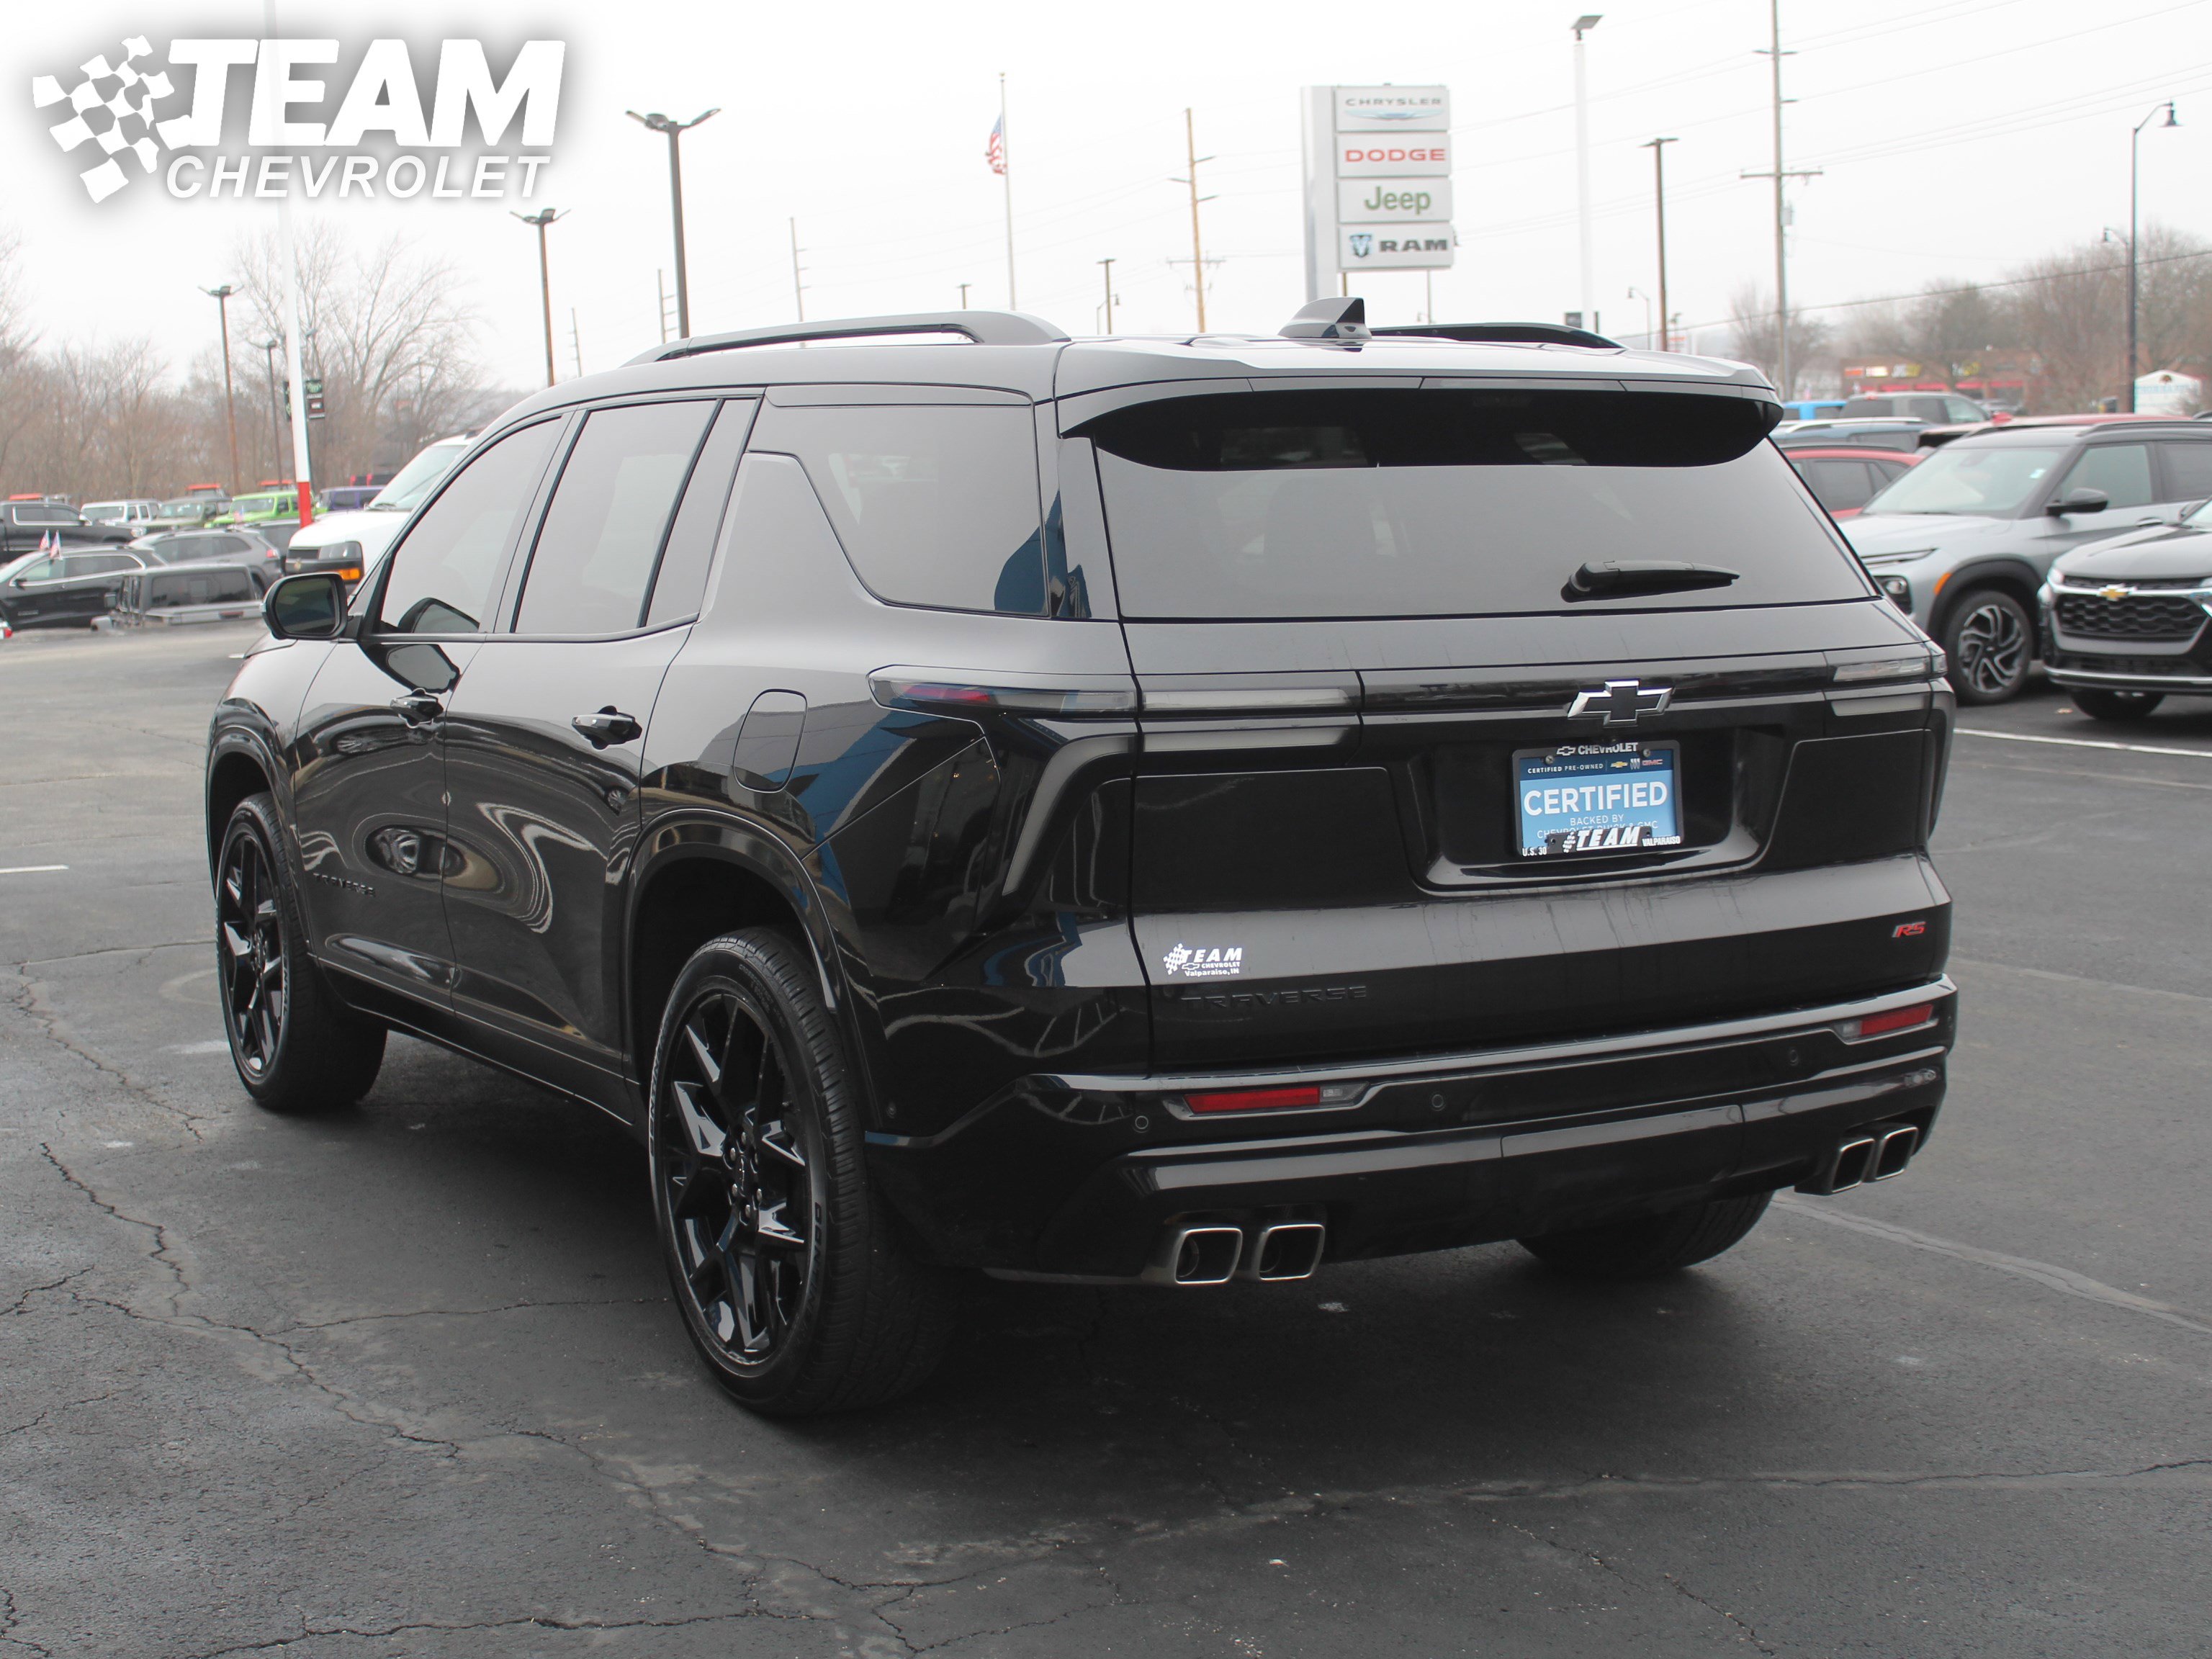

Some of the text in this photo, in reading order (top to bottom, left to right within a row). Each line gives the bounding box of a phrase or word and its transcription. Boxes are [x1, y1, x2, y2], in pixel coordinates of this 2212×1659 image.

[1345, 98, 1442, 107] CHRYSLER
[1345, 149, 1446, 162] DODGE
[1364, 186, 1431, 215] Jeep
[1380, 239, 1448, 252] RAM
[1578, 742, 1638, 755] CHEVROLET
[1564, 763, 1604, 772] PRE-OWNED
[1524, 781, 1668, 816] CERTIFIED
[1570, 814, 1624, 826] BACKED BY
[1577, 826, 1640, 849] TEAM
[1642, 835, 1681, 847] VALPARAISO
[1522, 846, 1547, 857] U.S. 30
[313, 872, 376, 897] TRAVERSE
[1892, 921, 1927, 938] RS
[1182, 948, 1242, 963] TEAM
[1181, 986, 1366, 1009] TRAVERSE
